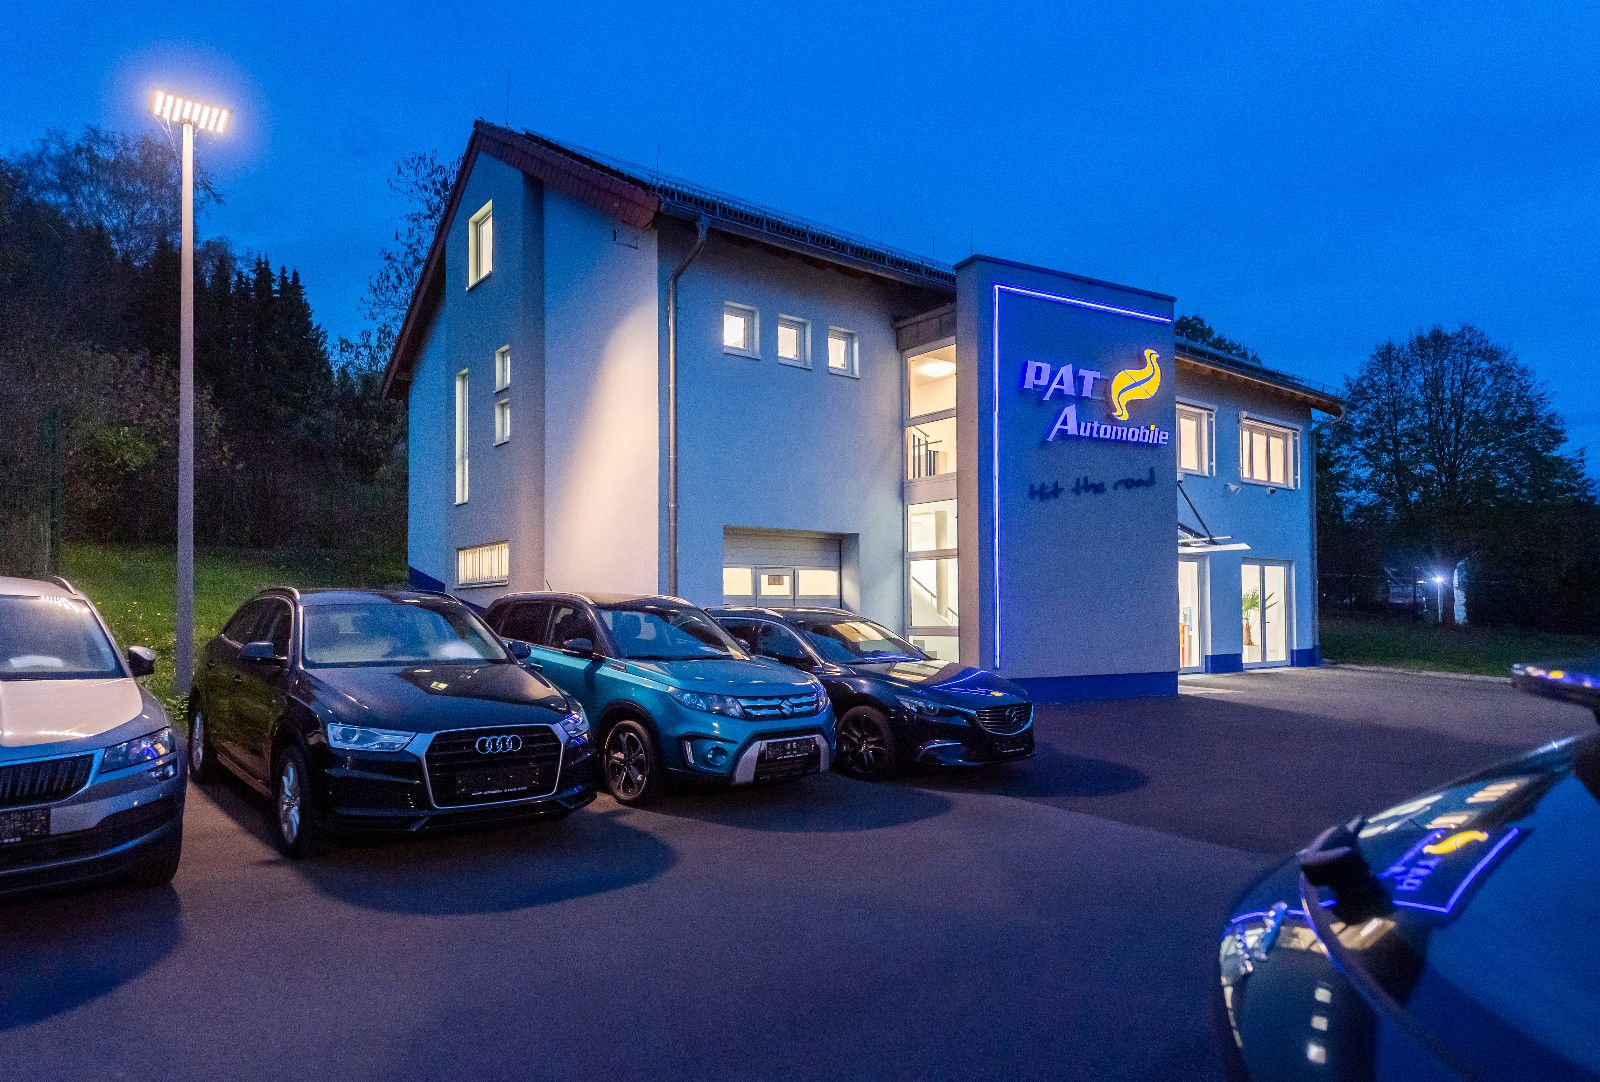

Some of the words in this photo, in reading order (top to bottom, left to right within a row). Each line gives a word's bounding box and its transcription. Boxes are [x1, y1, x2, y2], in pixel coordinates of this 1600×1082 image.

[1023, 360, 1101, 401] PAT
[1046, 404, 1169, 445] Automobile
[1071, 476, 1107, 496] the
